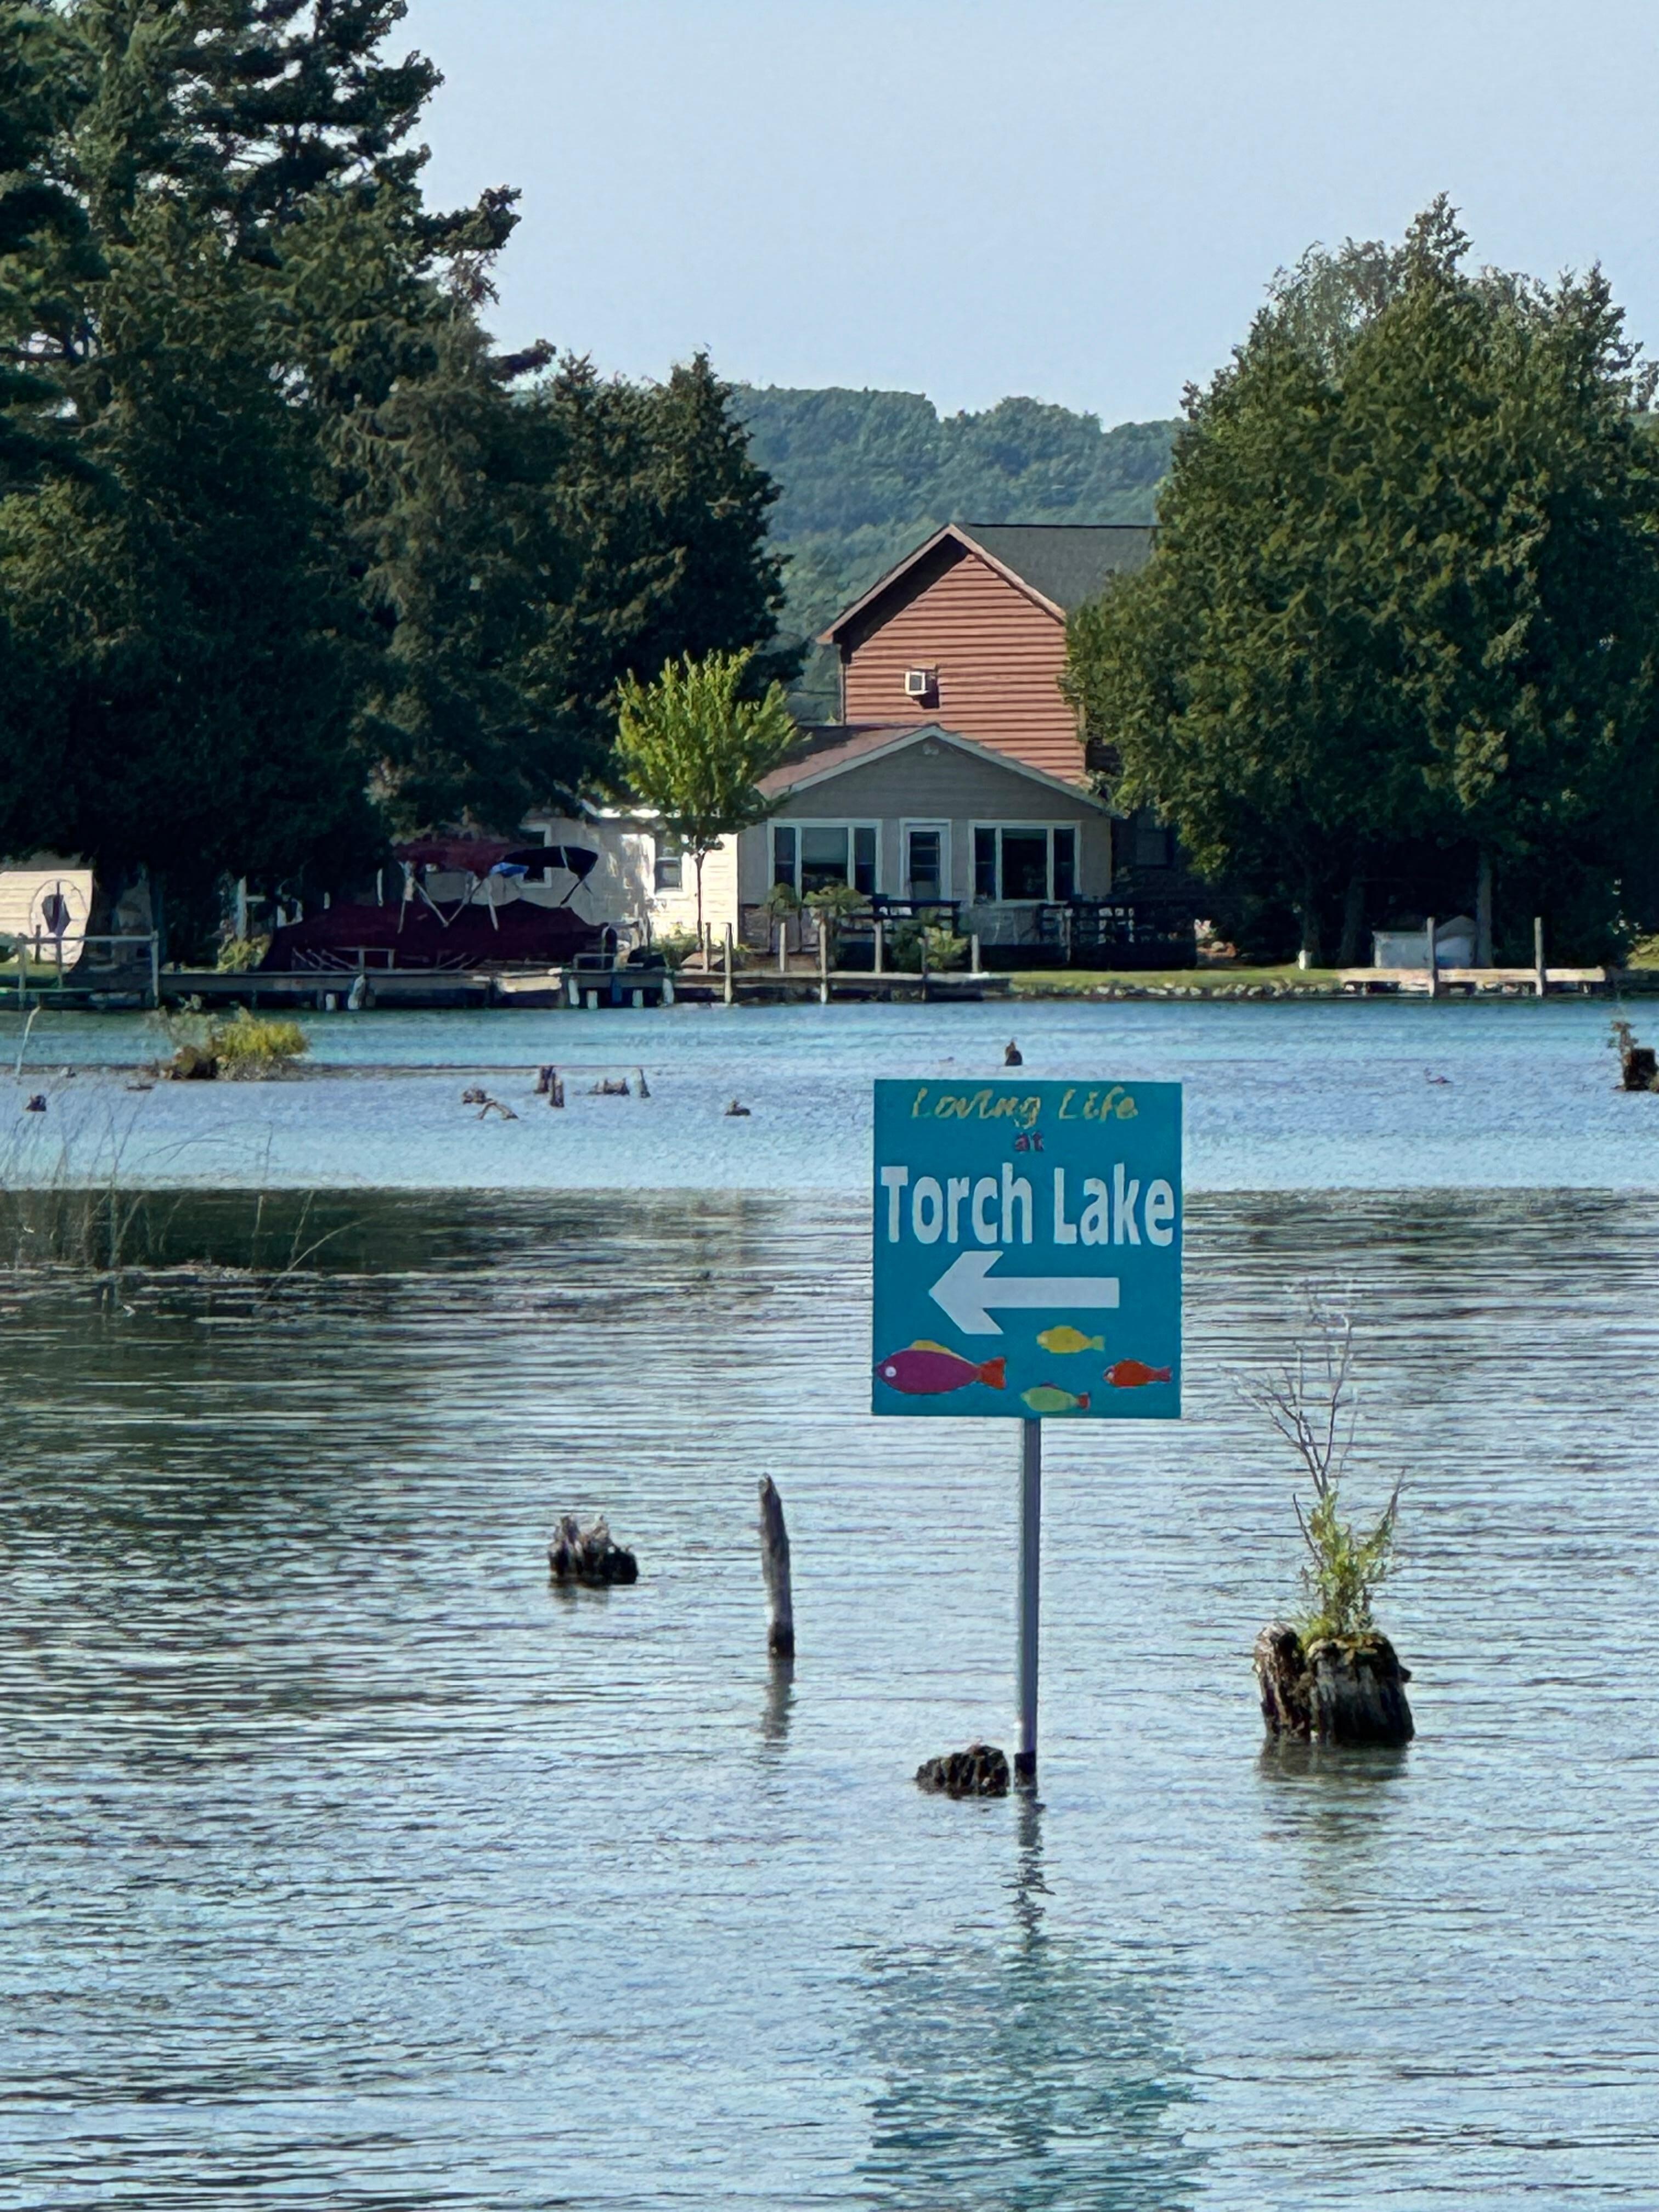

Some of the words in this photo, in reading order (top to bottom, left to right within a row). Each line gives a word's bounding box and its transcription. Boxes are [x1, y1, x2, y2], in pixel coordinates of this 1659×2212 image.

[911, 1087, 1041, 1129] Loving
[1059, 1085, 1138, 1122] Life
[1014, 1131, 1044, 1153] at
[881, 1162, 1032, 1244] Torch
[1053, 1162, 1175, 1246] Lake
